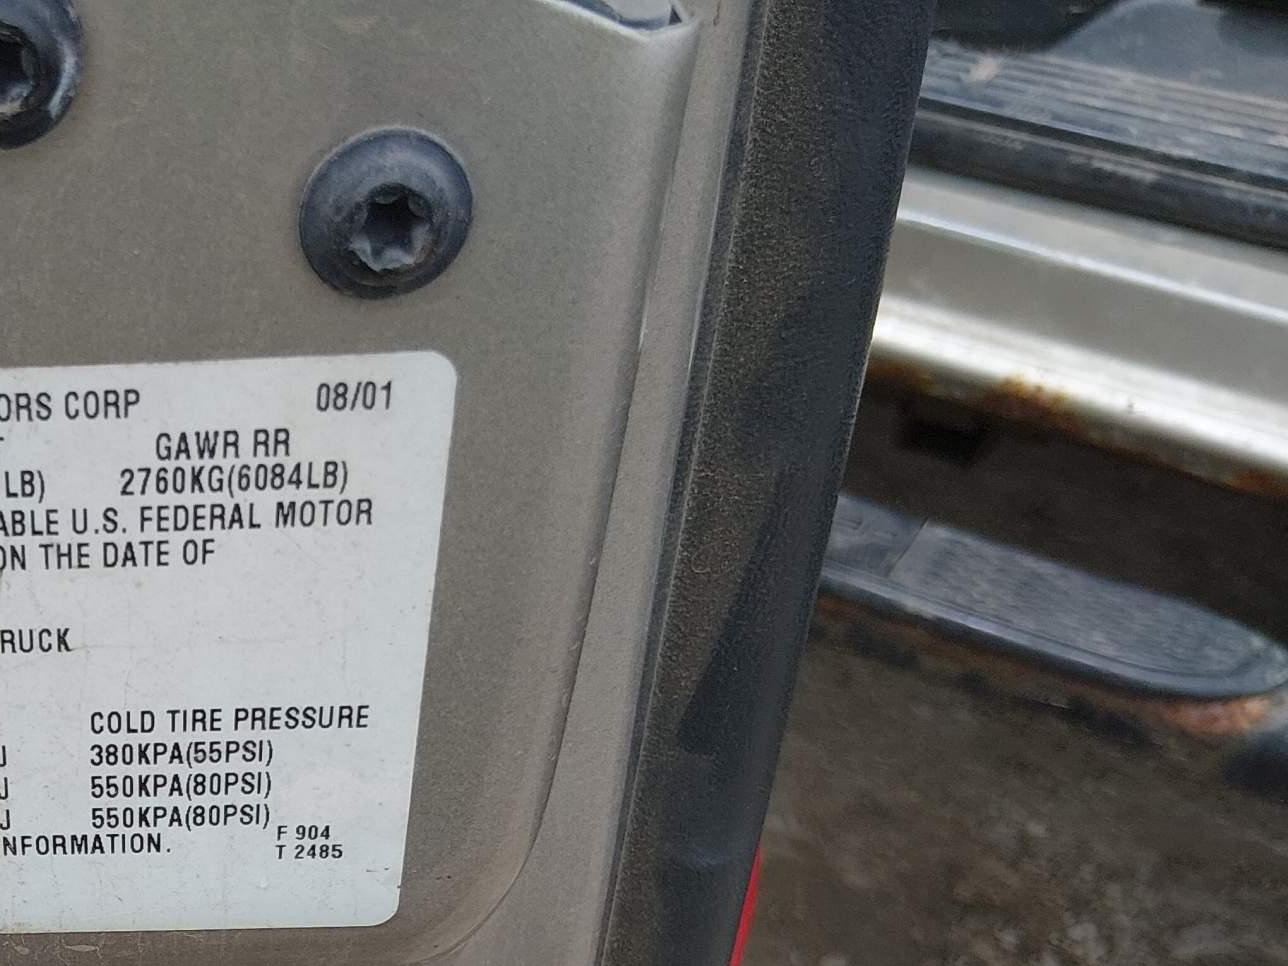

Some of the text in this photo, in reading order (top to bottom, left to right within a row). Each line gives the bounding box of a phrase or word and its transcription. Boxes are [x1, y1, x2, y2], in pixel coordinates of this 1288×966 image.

[65, 389, 140, 419] CORP
[317, 381, 391, 411] 08/01
[156, 428, 289, 460] GAWR RR
[121, 461, 347, 498] 2760KG(6084LB)
[72, 507, 126, 534] U.S.
[141, 503, 261, 532] FEDERAL
[276, 498, 372, 528] MOTOR
[39, 543, 89, 569] THE
[103, 540, 169, 567] DATE
[183, 539, 214, 565] OF
[91, 705, 369, 734] COLD TIRE PRESSURE
[91, 740, 272, 768] 380KPA(55PSI)
[91, 772, 271, 801] 550KPA(80PSI)
[92, 804, 269, 831] 550KPA(80PSI)
[278, 825, 329, 840] F 904
[276, 844, 342, 859] T 2485
